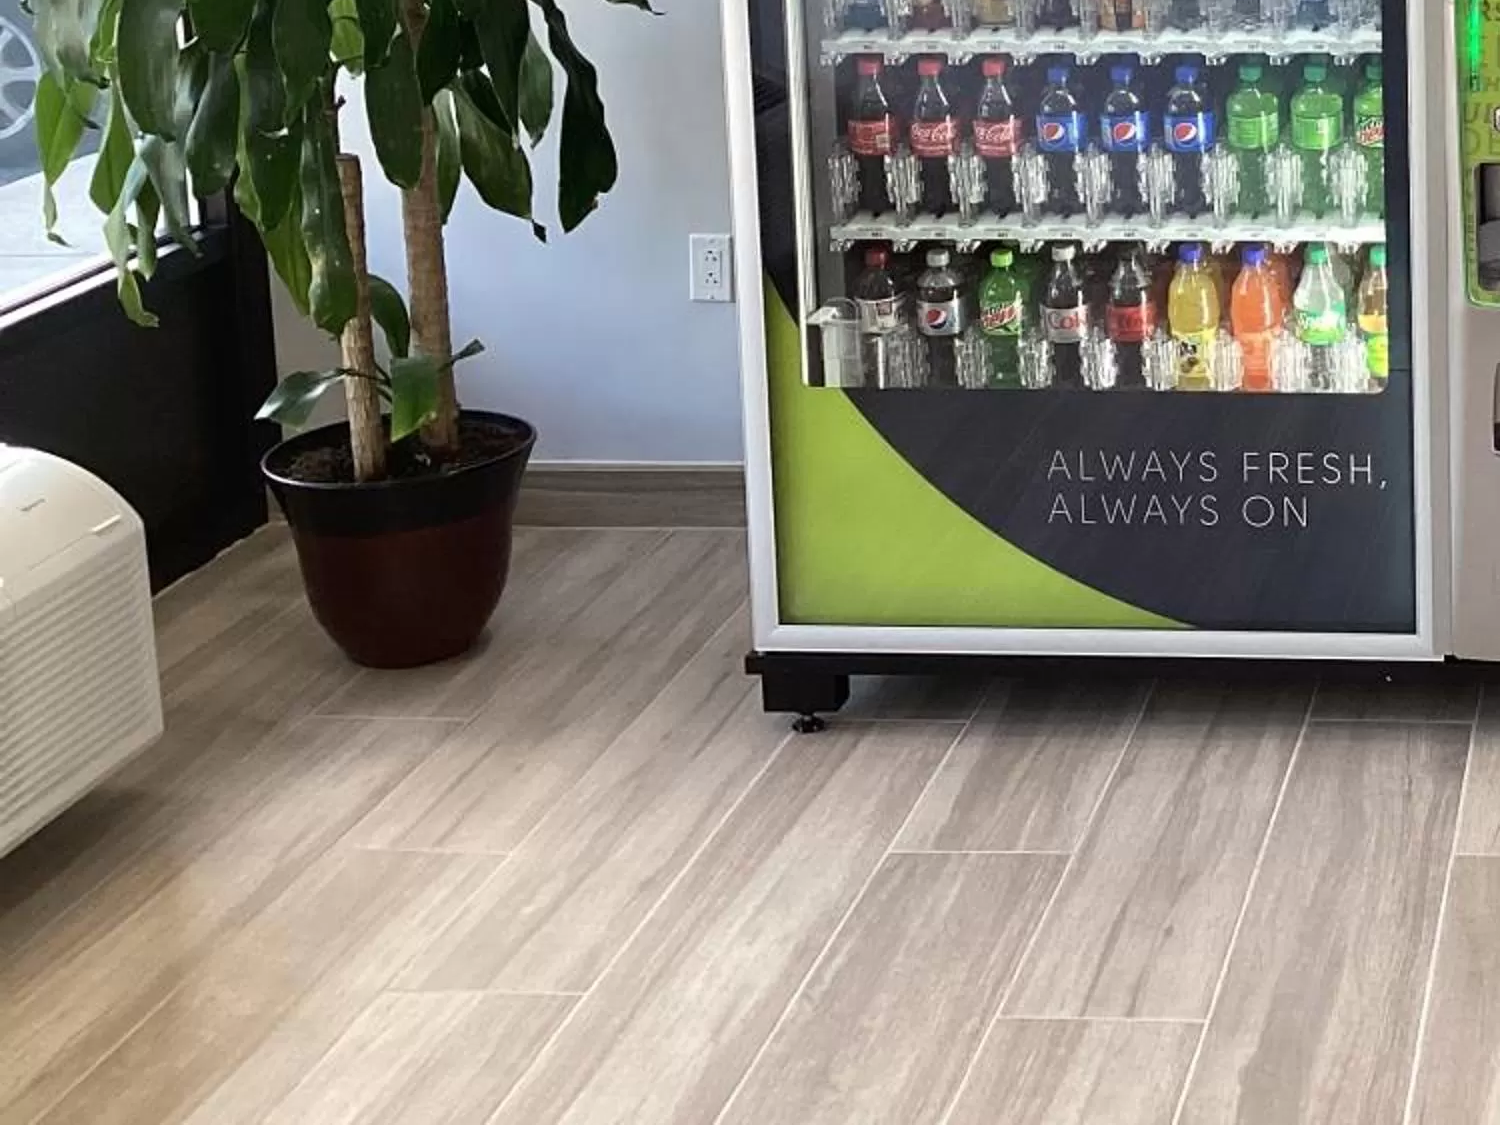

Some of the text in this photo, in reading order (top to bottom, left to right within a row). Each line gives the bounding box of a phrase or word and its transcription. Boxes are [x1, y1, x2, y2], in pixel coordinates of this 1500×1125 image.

[1048, 450, 1387, 489] ALWAYS FRESH,
[1048, 493, 1307, 527] ALWAYS ON
